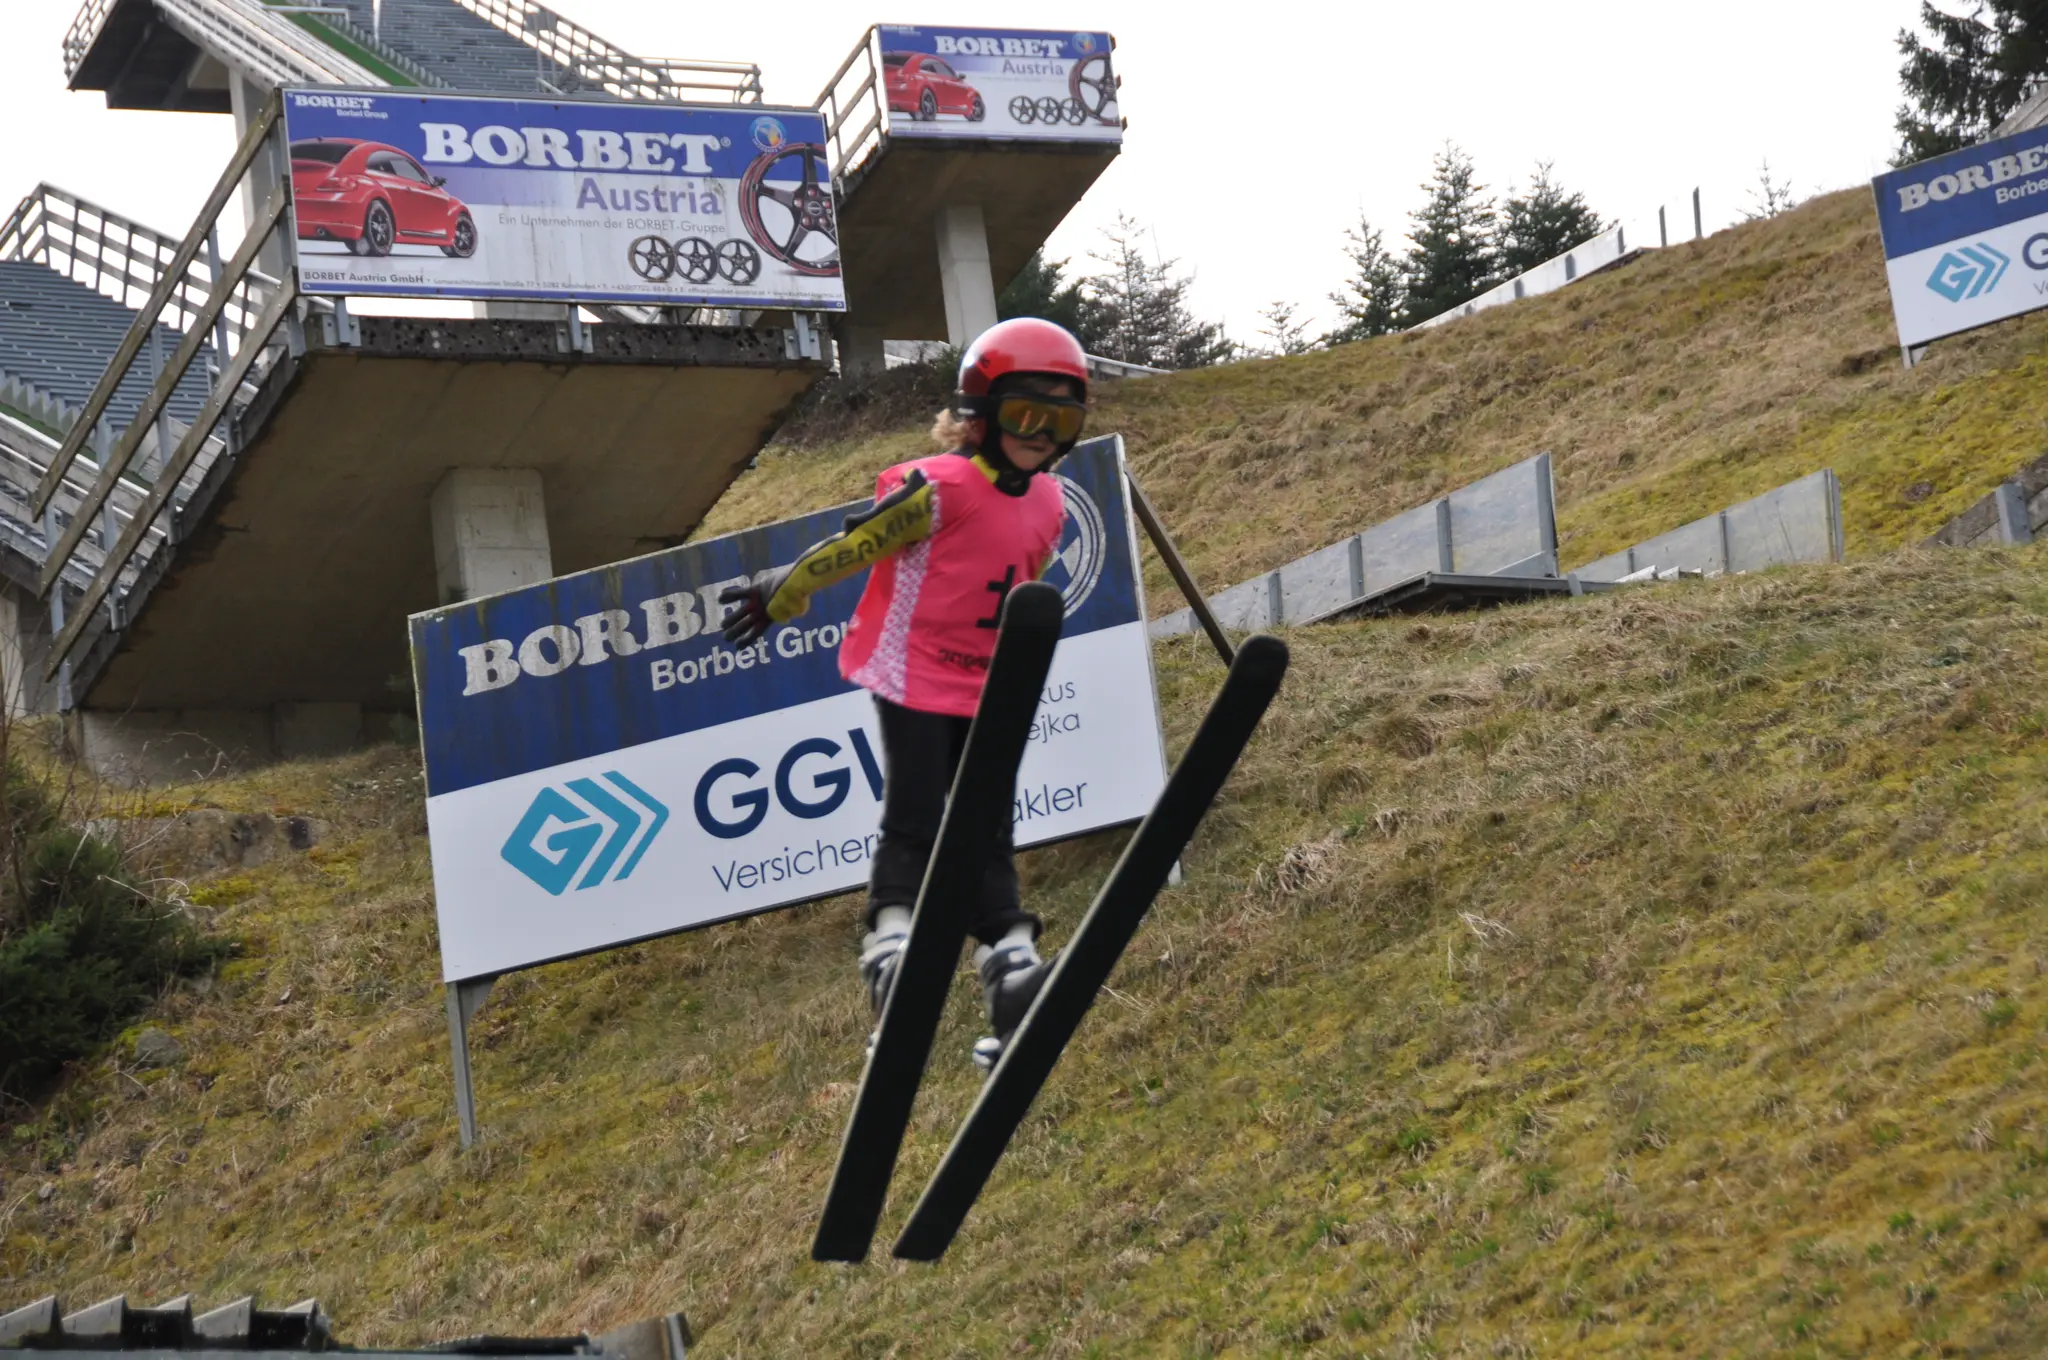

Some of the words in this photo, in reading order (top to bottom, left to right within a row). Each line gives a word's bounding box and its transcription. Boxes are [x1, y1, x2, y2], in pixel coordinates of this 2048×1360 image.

[934, 36, 1063, 58] BORBET
[1002, 59, 1064, 76] Austria
[294, 94, 375, 109] BORBET
[1897, 144, 2048, 213] BORBE
[576, 177, 723, 215] Austria
[499, 213, 516, 225] Ein
[520, 214, 600, 229] Unternehmen
[603, 217, 623, 229] der
[304, 271, 346, 282] BORBET
[349, 273, 387, 283] Austria
[391, 274, 424, 285] GmbH
[458, 563, 797, 696] BORBE
[650, 634, 771, 691] Borbet
[775, 620, 850, 659] Gro
